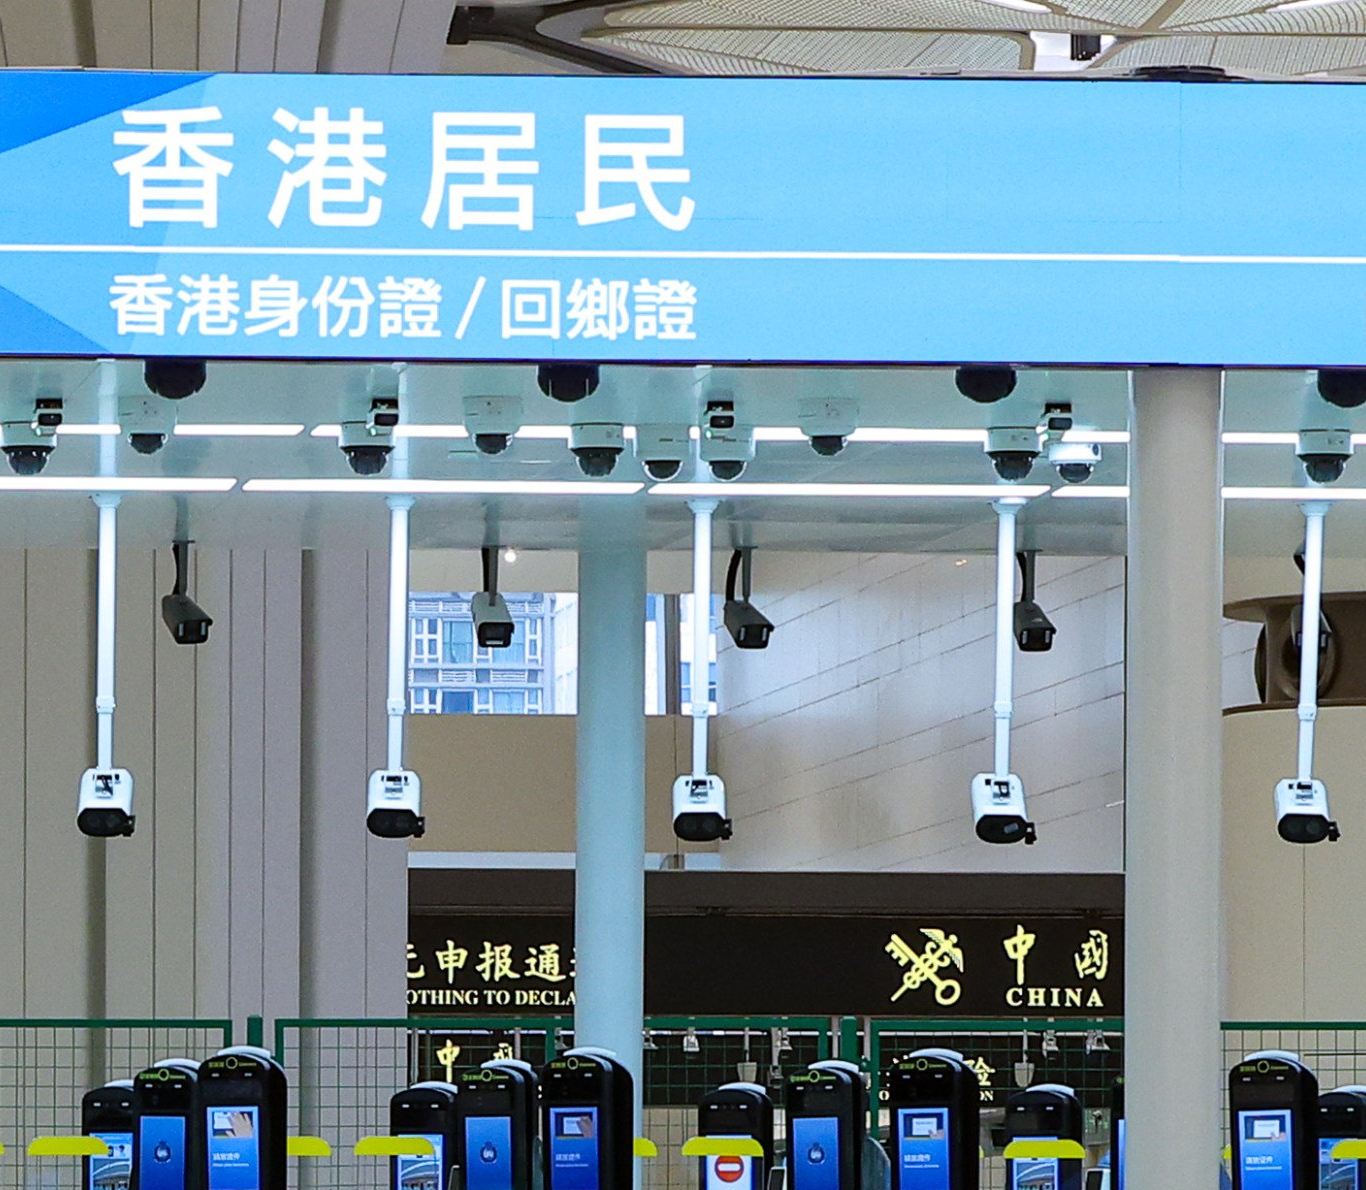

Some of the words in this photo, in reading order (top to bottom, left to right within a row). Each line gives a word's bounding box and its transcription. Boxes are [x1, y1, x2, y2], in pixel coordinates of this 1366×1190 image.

[112, 106, 695, 231] 香港居民
[407, 940, 576, 985] 申报通
[484, 989, 511, 1006] TO
[1006, 987, 1104, 1007] CHINA
